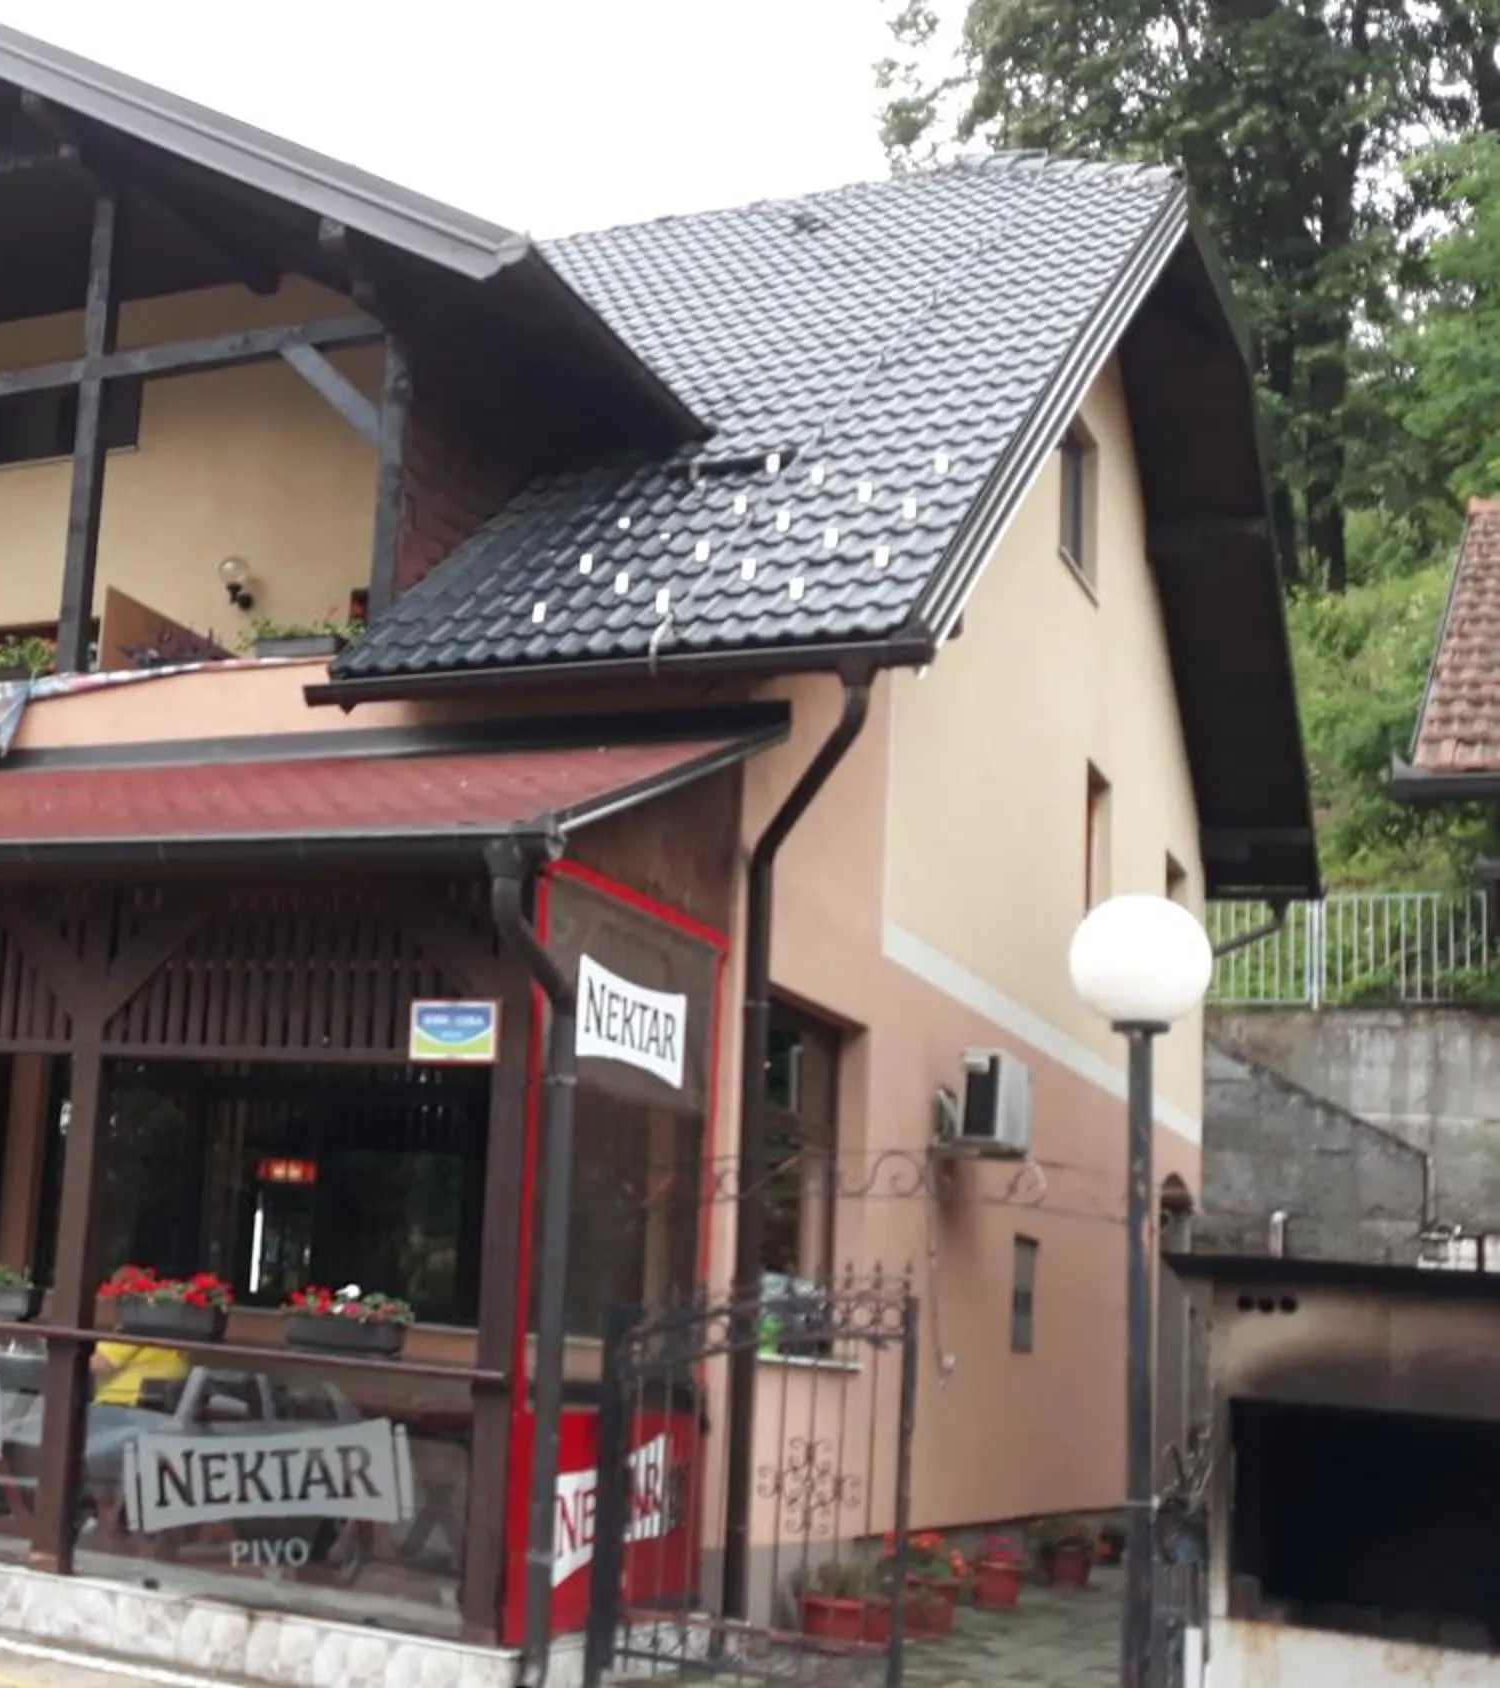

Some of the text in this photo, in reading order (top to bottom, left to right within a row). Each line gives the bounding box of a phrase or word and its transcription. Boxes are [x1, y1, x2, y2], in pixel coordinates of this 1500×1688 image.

[584, 975, 676, 1063] NEKTAR
[155, 1446, 382, 1508] NEKTAR
[230, 1537, 310, 1568] PIVO
